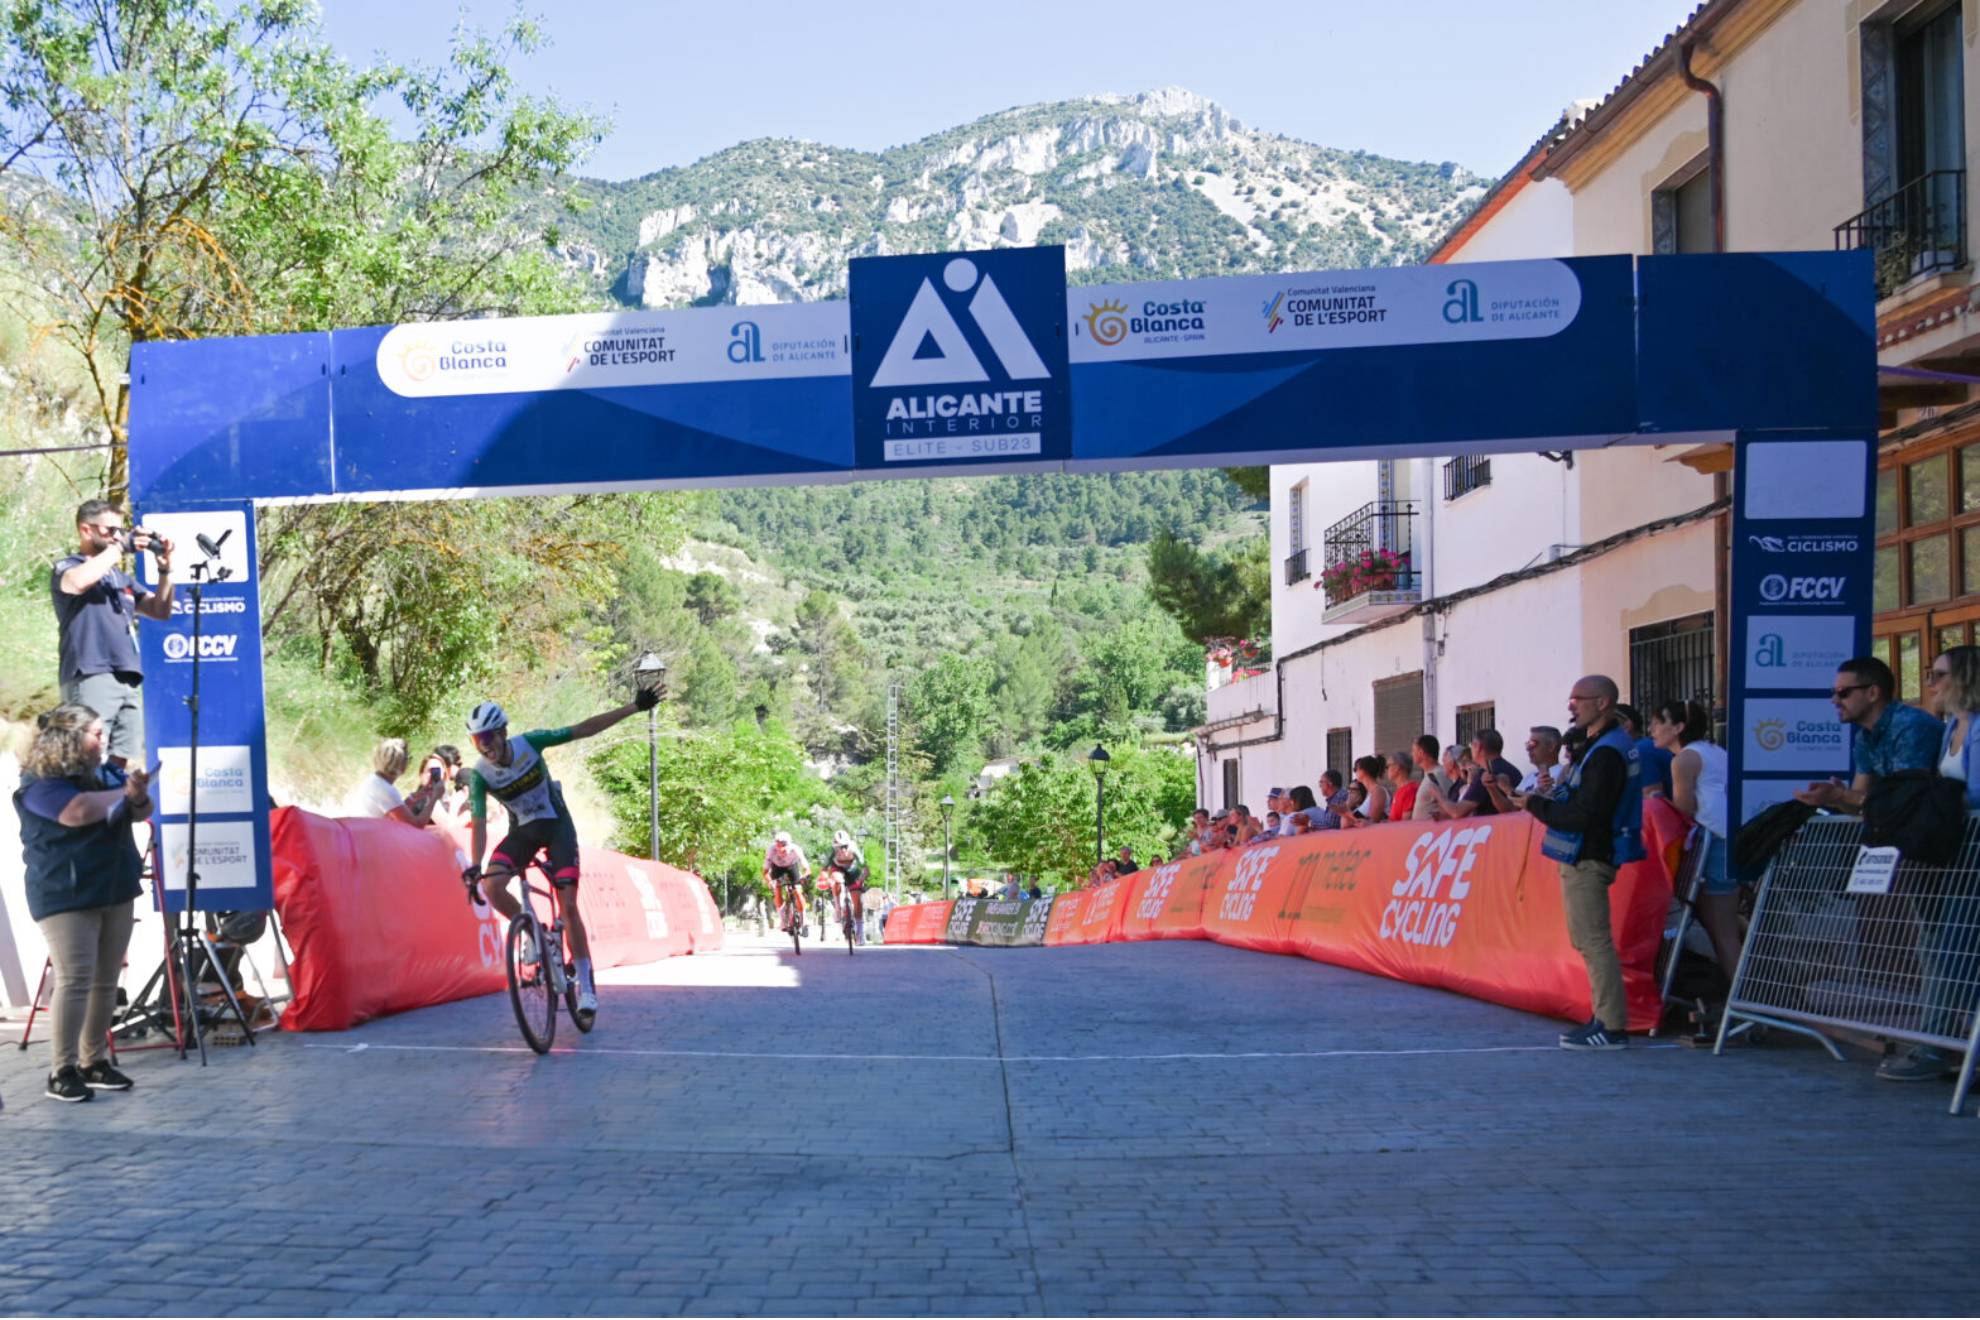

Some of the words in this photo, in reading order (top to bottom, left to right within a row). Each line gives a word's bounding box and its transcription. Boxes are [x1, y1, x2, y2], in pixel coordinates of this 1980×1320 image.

[1288, 287, 1329, 296] Comunitat
[1331, 285, 1376, 294] Valenciana
[1143, 298, 1204, 316] Costa
[1287, 296, 1376, 313] COMUNITAT
[1491, 297, 1559, 310] DIPUTACIÓN
[1294, 313, 1314, 326] DE
[1318, 309, 1387, 325] L'ESPORT
[1491, 312, 1504, 322] DE
[1508, 310, 1559, 321] ALICANTE
[1130, 317, 1205, 334] Blanca
[451, 340, 507, 355] Costa
[585, 337, 665, 353] COMUNITAT
[772, 339, 836, 351] DIPUTACIÓN
[439, 356, 507, 371] Blanca
[590, 353, 611, 366] DE
[612, 349, 676, 365] L'ESPORT
[772, 352, 784, 362] DE
[788, 351, 835, 361] ALICANTE
[886, 390, 1042, 420] ALICANTE
[886, 415, 1042, 434] INTERIOR
[893, 440, 947, 456] ELITE
[971, 437, 1031, 452] SUB23
[1787, 541, 1858, 552] CICLISMO
[1788, 577, 1846, 599] FCCV
[184, 601, 246, 615] CCLISMO
[1796, 720, 1841, 732] Costa
[1786, 731, 1841, 744] Blanca
[187, 846, 240, 856] OMUNITAT
[1227, 846, 1280, 893] SAFE
[1392, 824, 1493, 900] SAFE
[1143, 863, 1182, 898] SAFE
[1379, 899, 1462, 948] CYCLING
